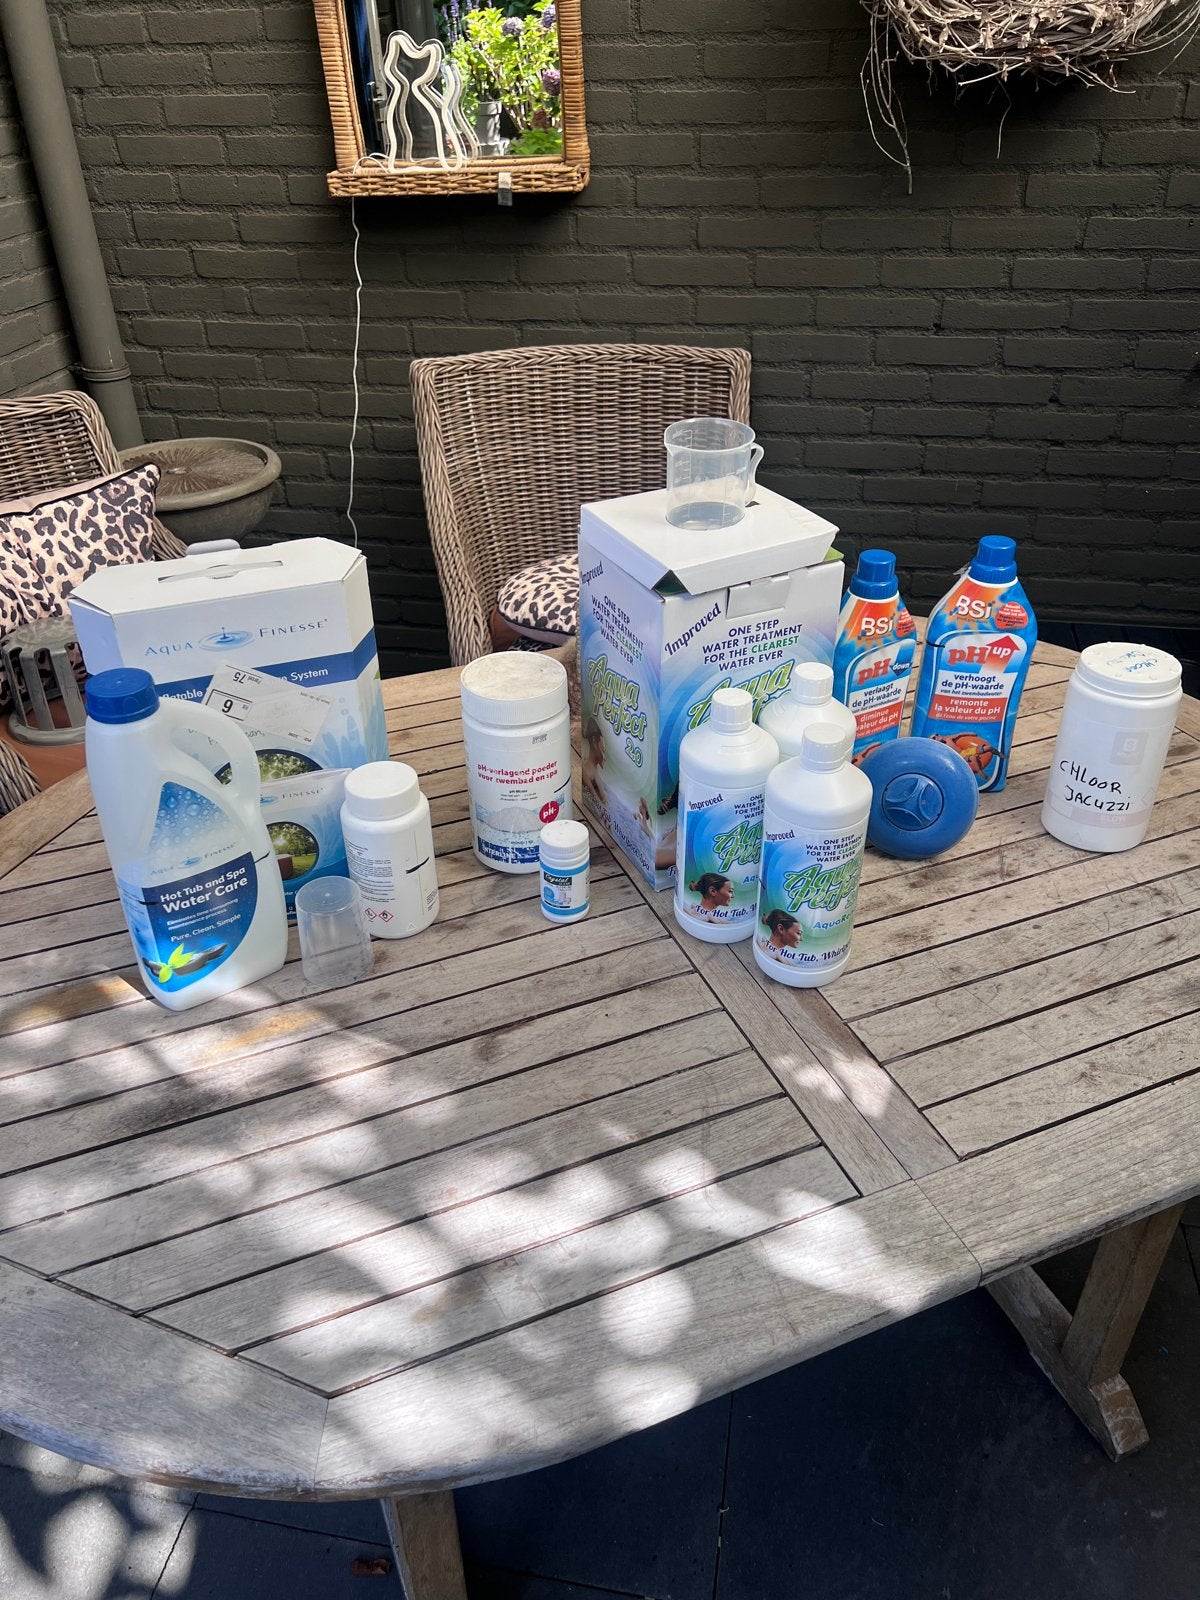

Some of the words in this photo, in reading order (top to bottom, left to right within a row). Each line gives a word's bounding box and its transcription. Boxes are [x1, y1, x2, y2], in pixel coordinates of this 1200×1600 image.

[604, 596, 616, 613] ONE
[618, 609, 630, 625] STEP
[592, 595, 610, 619] WATER
[611, 614, 644, 650] TREATMENT
[664, 602, 721, 656] Improved
[728, 625, 752, 638] ONE
[756, 619, 779, 632] STEP
[592, 608, 604, 624] FOR
[605, 619, 614, 634] THE
[616, 631, 642, 661] CLEAREST
[600, 626, 618, 650] WATER
[702, 639, 738, 654] WATER
[743, 624, 802, 645] TREATMENT
[145, 642, 193, 656] AQUA
[704, 652, 724, 664] FOR
[729, 648, 748, 658] THE
[752, 636, 800, 653] CLEAREST
[948, 646, 990, 665] pH
[992, 647, 1010, 658] up
[718, 656, 754, 672] WATER
[758, 650, 783, 662] EVER
[234, 671, 246, 684] 75
[291, 668, 328, 682] System
[857, 658, 891, 685] pH
[954, 674, 996, 682] verhoogt
[587, 654, 640, 710] Aqua
[864, 683, 893, 696] verlaagt
[942, 680, 954, 688] de
[954, 681, 1004, 690] pH-waarde
[161, 688, 204, 701] table
[852, 699, 862, 708] de
[863, 688, 902, 706] pH-waarde
[221, 699, 234, 713] 6
[591, 682, 647, 741] Perfect
[935, 704, 942, 712] la
[945, 706, 974, 714] valeur
[988, 707, 1000, 716] pH
[856, 720, 878, 732] valeur
[878, 716, 887, 724] du
[888, 711, 898, 722] pH
[861, 708, 889, 722] diminue
[625, 738, 643, 768] 2.0
[532, 761, 557, 775] poeder
[478, 772, 493, 782] voor
[496, 776, 534, 784] zwembad
[546, 769, 558, 780] spa
[689, 794, 724, 810] Improved
[750, 794, 762, 802] ONE
[734, 802, 756, 810] WATER
[735, 808, 748, 816] FOR
[766, 830, 795, 842] Improved
[842, 834, 854, 842] STEP
[842, 850, 856, 860] EVER
[160, 892, 182, 902] Hot
[183, 884, 203, 896] Tub
[205, 876, 224, 888] and
[226, 868, 246, 880] Spa
[163, 892, 212, 914] Water
[215, 878, 248, 896] Care
[696, 904, 710, 916] For
[712, 909, 728, 918] Hot
[216, 914, 241, 928] Simple
[766, 940, 777, 952] For
[780, 947, 796, 960] Hot
